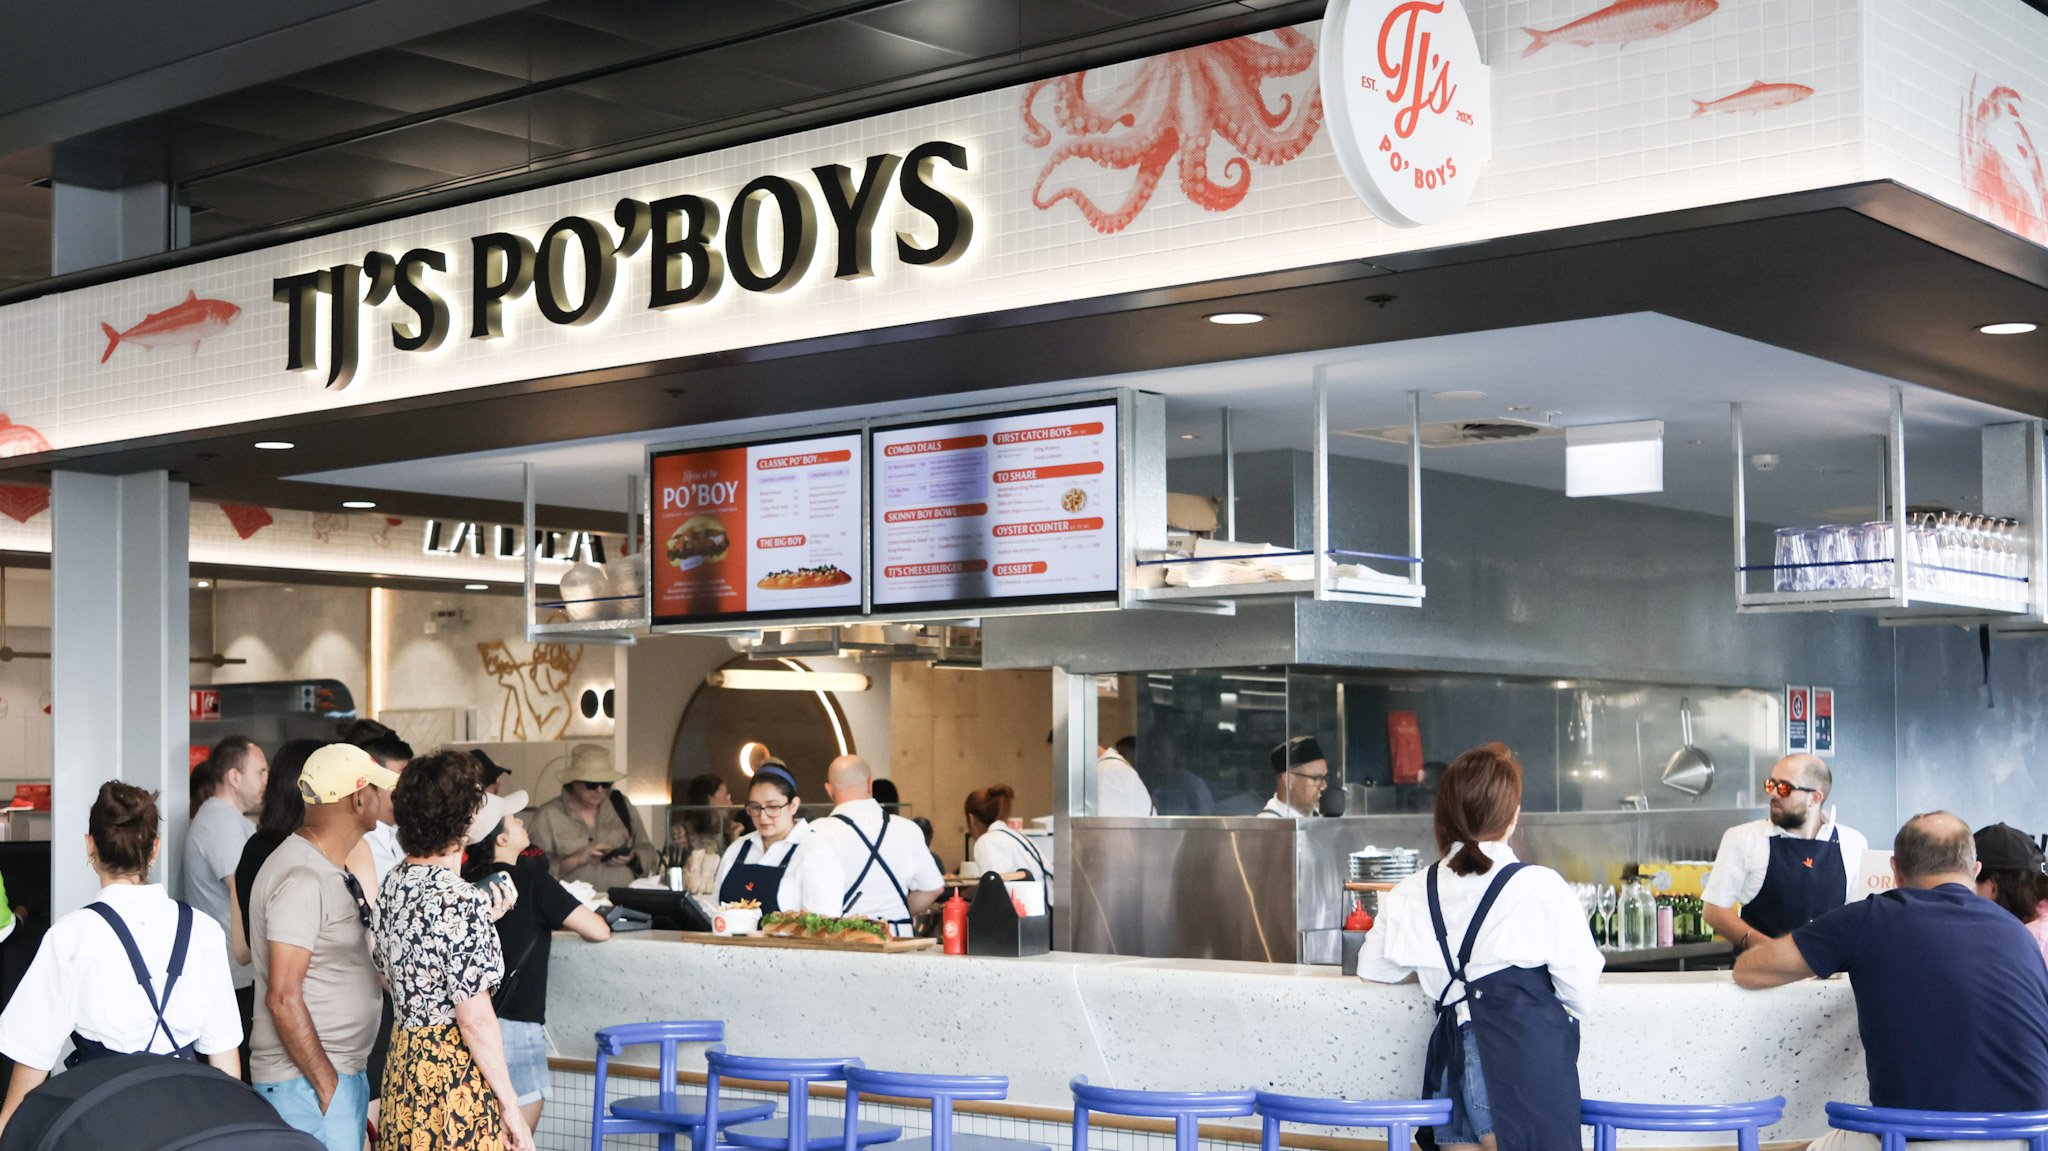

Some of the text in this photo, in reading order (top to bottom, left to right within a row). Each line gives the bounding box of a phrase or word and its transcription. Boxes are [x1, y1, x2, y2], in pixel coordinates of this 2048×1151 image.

[1377, 1, 1457, 138] TJ's
[1361, 75, 1474, 126] EST. 2025
[273, 141, 974, 390] TJ'S PO'BOYS
[997, 432, 1020, 443] FIRST
[1020, 429, 1049, 441] CATCH
[1049, 426, 1072, 438] BOYS
[887, 441, 942, 456] COMBO DEALS
[759, 457, 789, 469] CLASSIC
[997, 470, 1037, 482] TO SHARE
[663, 480, 739, 510] PO'BOY
[888, 511, 917, 522] SKINNY
[917, 509, 933, 520] BOY
[934, 507, 958, 518] BOWL
[996, 524, 1028, 536] OYSTER
[1029, 521, 1070, 533] COUNTER
[760, 538, 774, 548] THE
[774, 537, 787, 547] BIG
[787, 536, 803, 546] BOY
[888, 562, 963, 578] TJ'S CHEESEBURGER
[997, 563, 1033, 575] DESSERT
